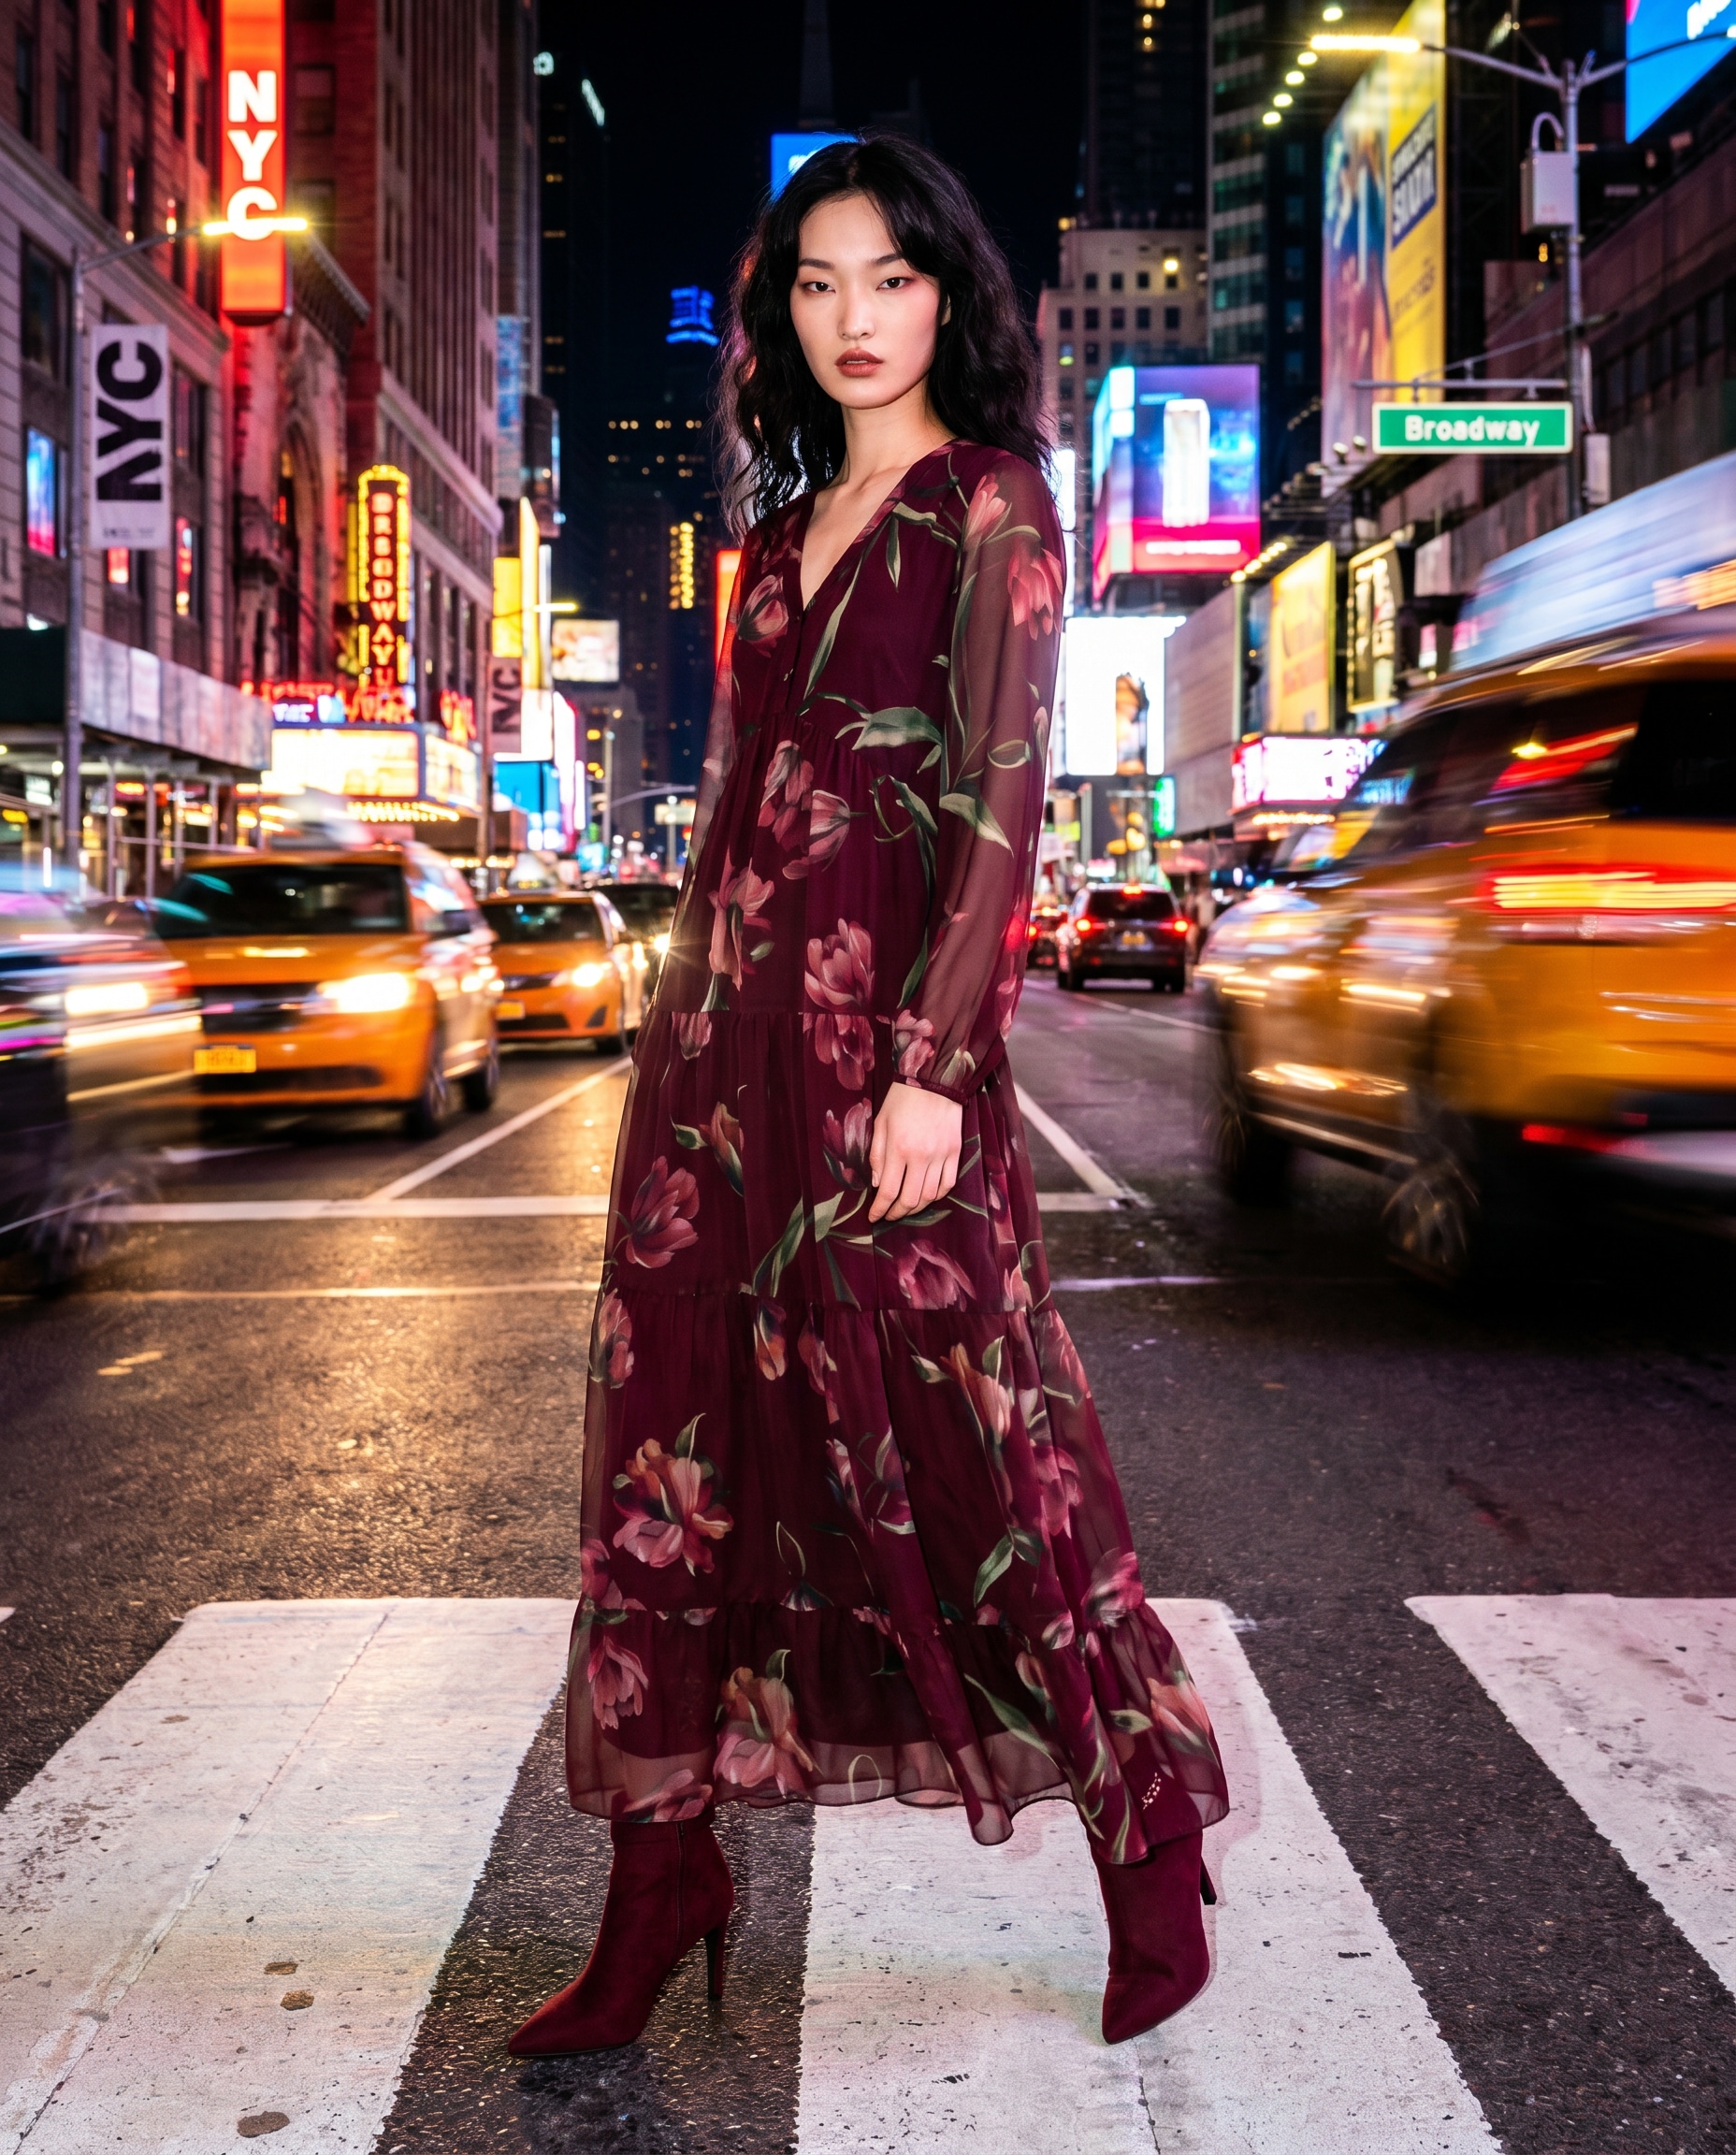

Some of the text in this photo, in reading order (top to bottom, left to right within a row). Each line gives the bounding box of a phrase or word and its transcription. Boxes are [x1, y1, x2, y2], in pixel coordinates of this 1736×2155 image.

[226, 70, 278, 240] NYC
[97, 340, 163, 501] NYC
[1405, 414, 1541, 447] Broadway
[492, 668, 521, 733] NYC
